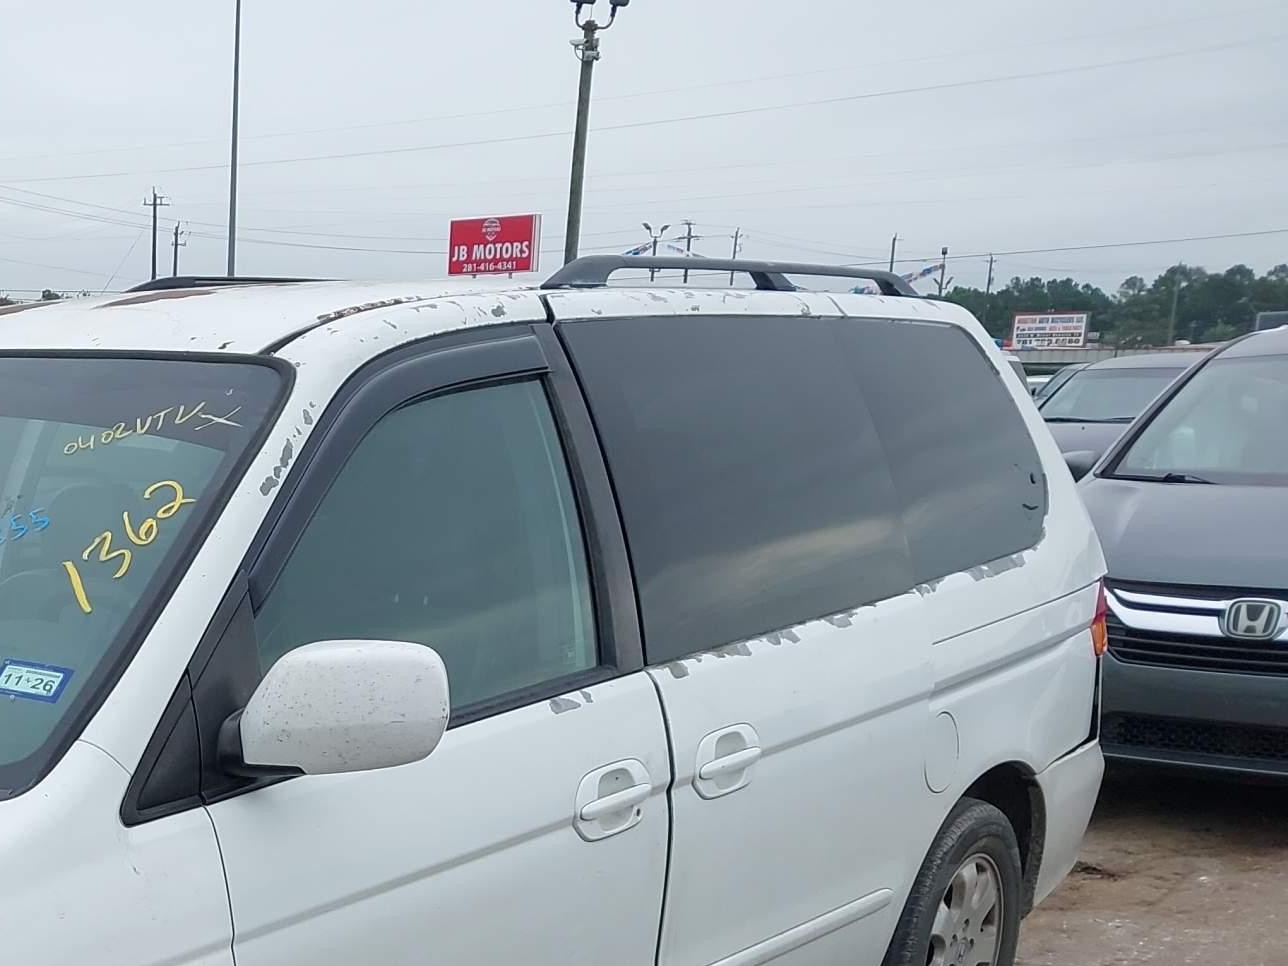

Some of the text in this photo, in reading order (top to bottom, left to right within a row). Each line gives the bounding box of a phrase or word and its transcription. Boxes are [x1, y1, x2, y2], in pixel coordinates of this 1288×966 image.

[452, 241, 529, 262] JB MOTORS
[462, 261, 516, 272] 281-416-4341
[62, 480, 196, 613] 1362
